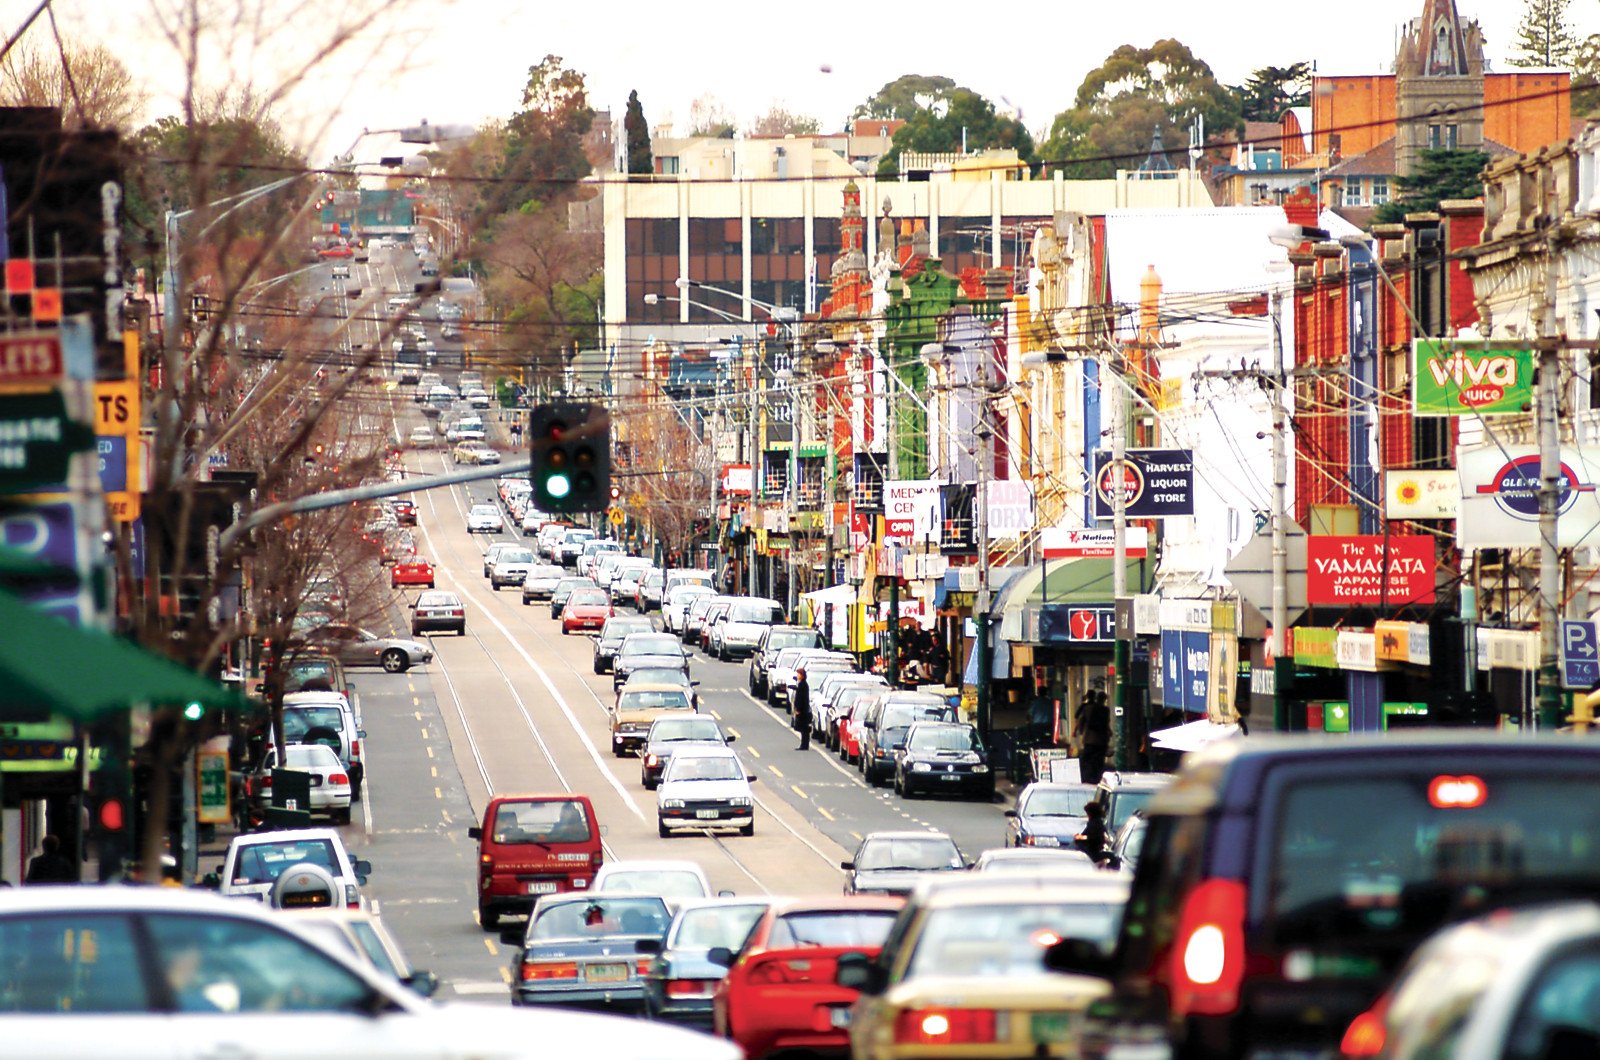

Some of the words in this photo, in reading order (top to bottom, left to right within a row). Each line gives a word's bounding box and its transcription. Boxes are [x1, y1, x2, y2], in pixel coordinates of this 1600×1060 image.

[1429, 350, 1518, 386] viva
[1146, 464, 1191, 473] HARVEST
[1104, 481, 1136, 490] TOEYS
[1151, 479, 1187, 488] LIQUOR
[1108, 489, 1134, 500] NW
[1153, 494, 1186, 503] STORE
[891, 522, 913, 532] OPEN
[1082, 533, 1115, 541] Nation
[1341, 543, 1365, 555] The
[1374, 543, 1401, 555] Nw
[1334, 576, 1409, 585] JAPANSE
[1334, 585, 1410, 597] Restauant
[1566, 625, 1586, 651] P
